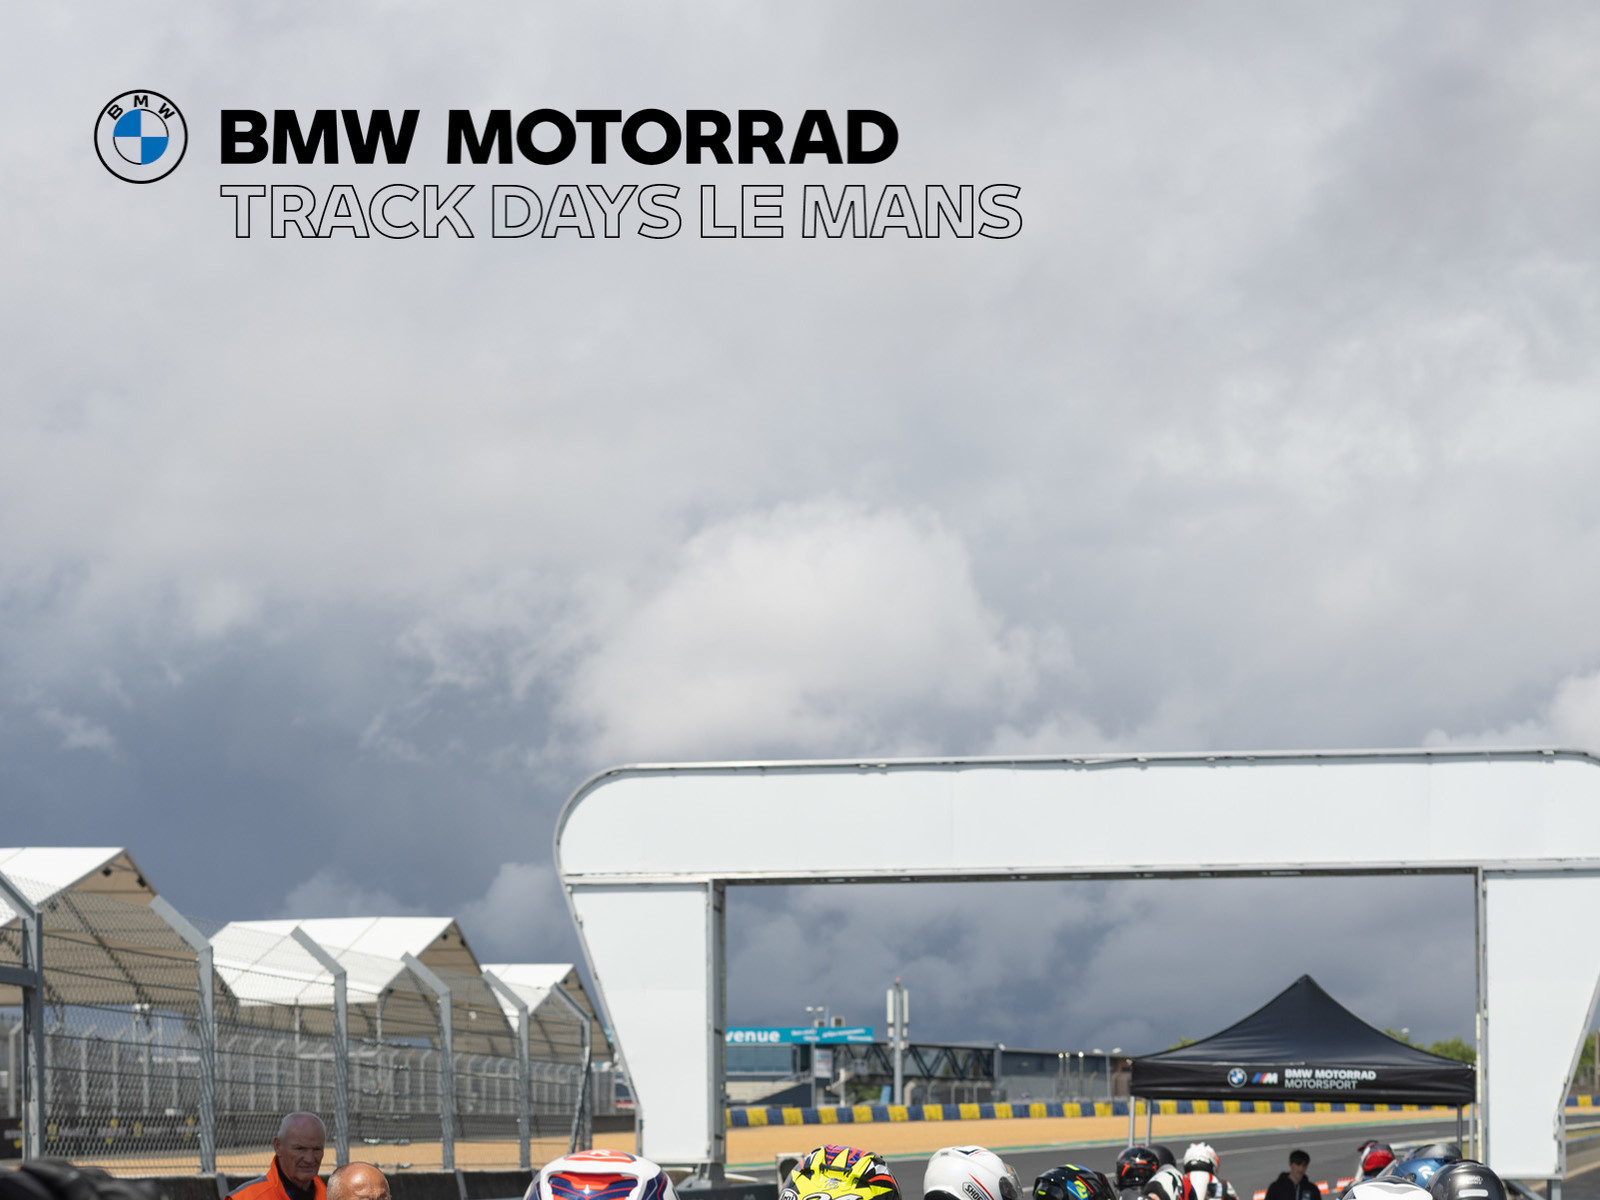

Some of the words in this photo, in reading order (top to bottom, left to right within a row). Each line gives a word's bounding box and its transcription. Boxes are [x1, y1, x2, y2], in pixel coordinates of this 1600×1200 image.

[1284, 1068, 1313, 1079] BMW
[1315, 1069, 1376, 1080] MOTORRAD
[1284, 1079, 1358, 1090] MOTORSPORT
